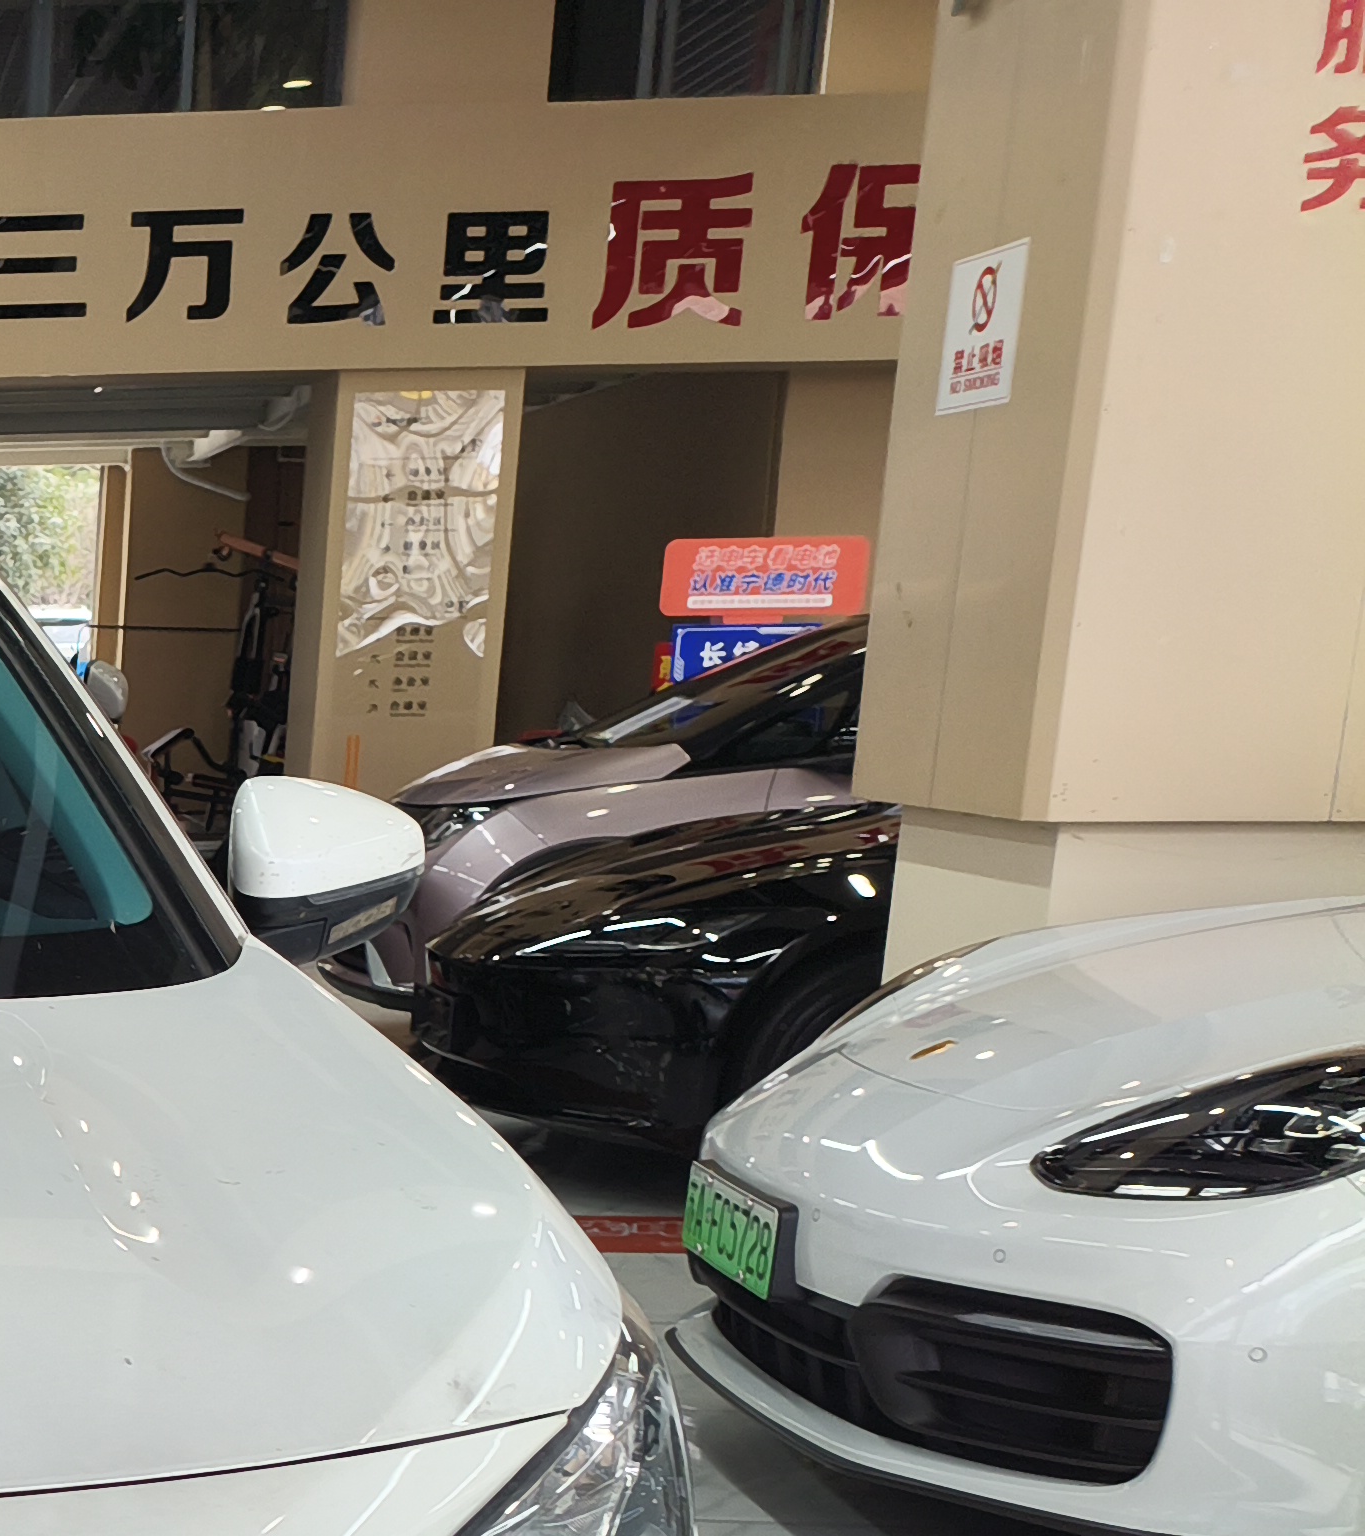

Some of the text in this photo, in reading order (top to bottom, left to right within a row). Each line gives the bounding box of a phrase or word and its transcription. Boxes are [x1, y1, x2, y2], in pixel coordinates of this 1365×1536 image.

[689, 570, 837, 594] 认准宁德时代
